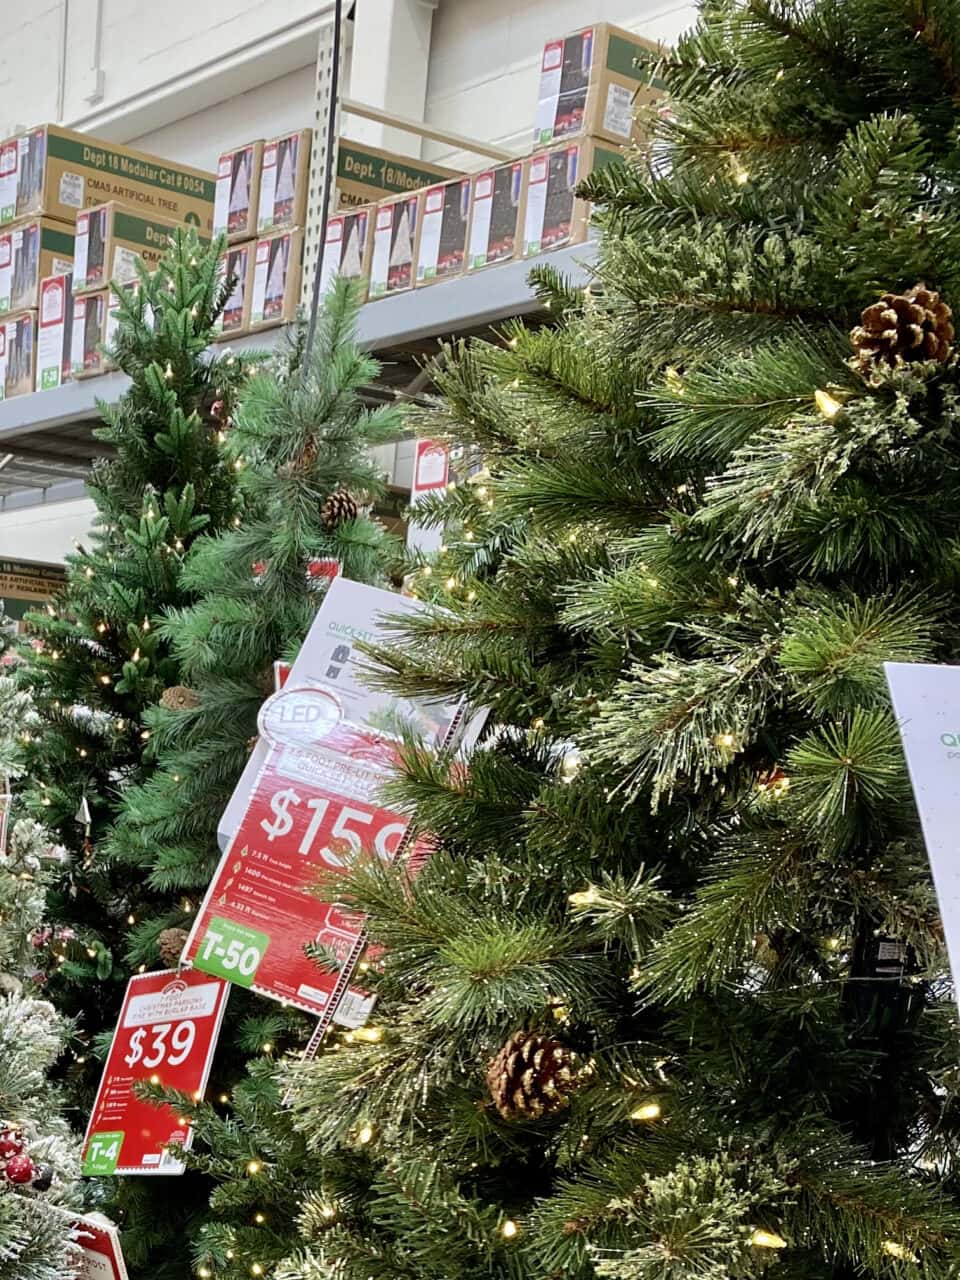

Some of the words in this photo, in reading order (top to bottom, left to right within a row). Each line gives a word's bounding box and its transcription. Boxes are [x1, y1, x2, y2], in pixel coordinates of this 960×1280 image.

[83, 147, 106, 167] Dept
[121, 159, 158, 180] Modular
[344, 156, 376, 179] Dept.
[87, 178, 111, 193] CMAS
[112, 185, 156, 206] ARTIFICIAL
[158, 198, 178, 212] TREE
[280, 704, 321, 723] LED
[202, 931, 261, 976] T-50
[124, 1020, 196, 1069] $39
[91, 1140, 119, 1162] T-4
